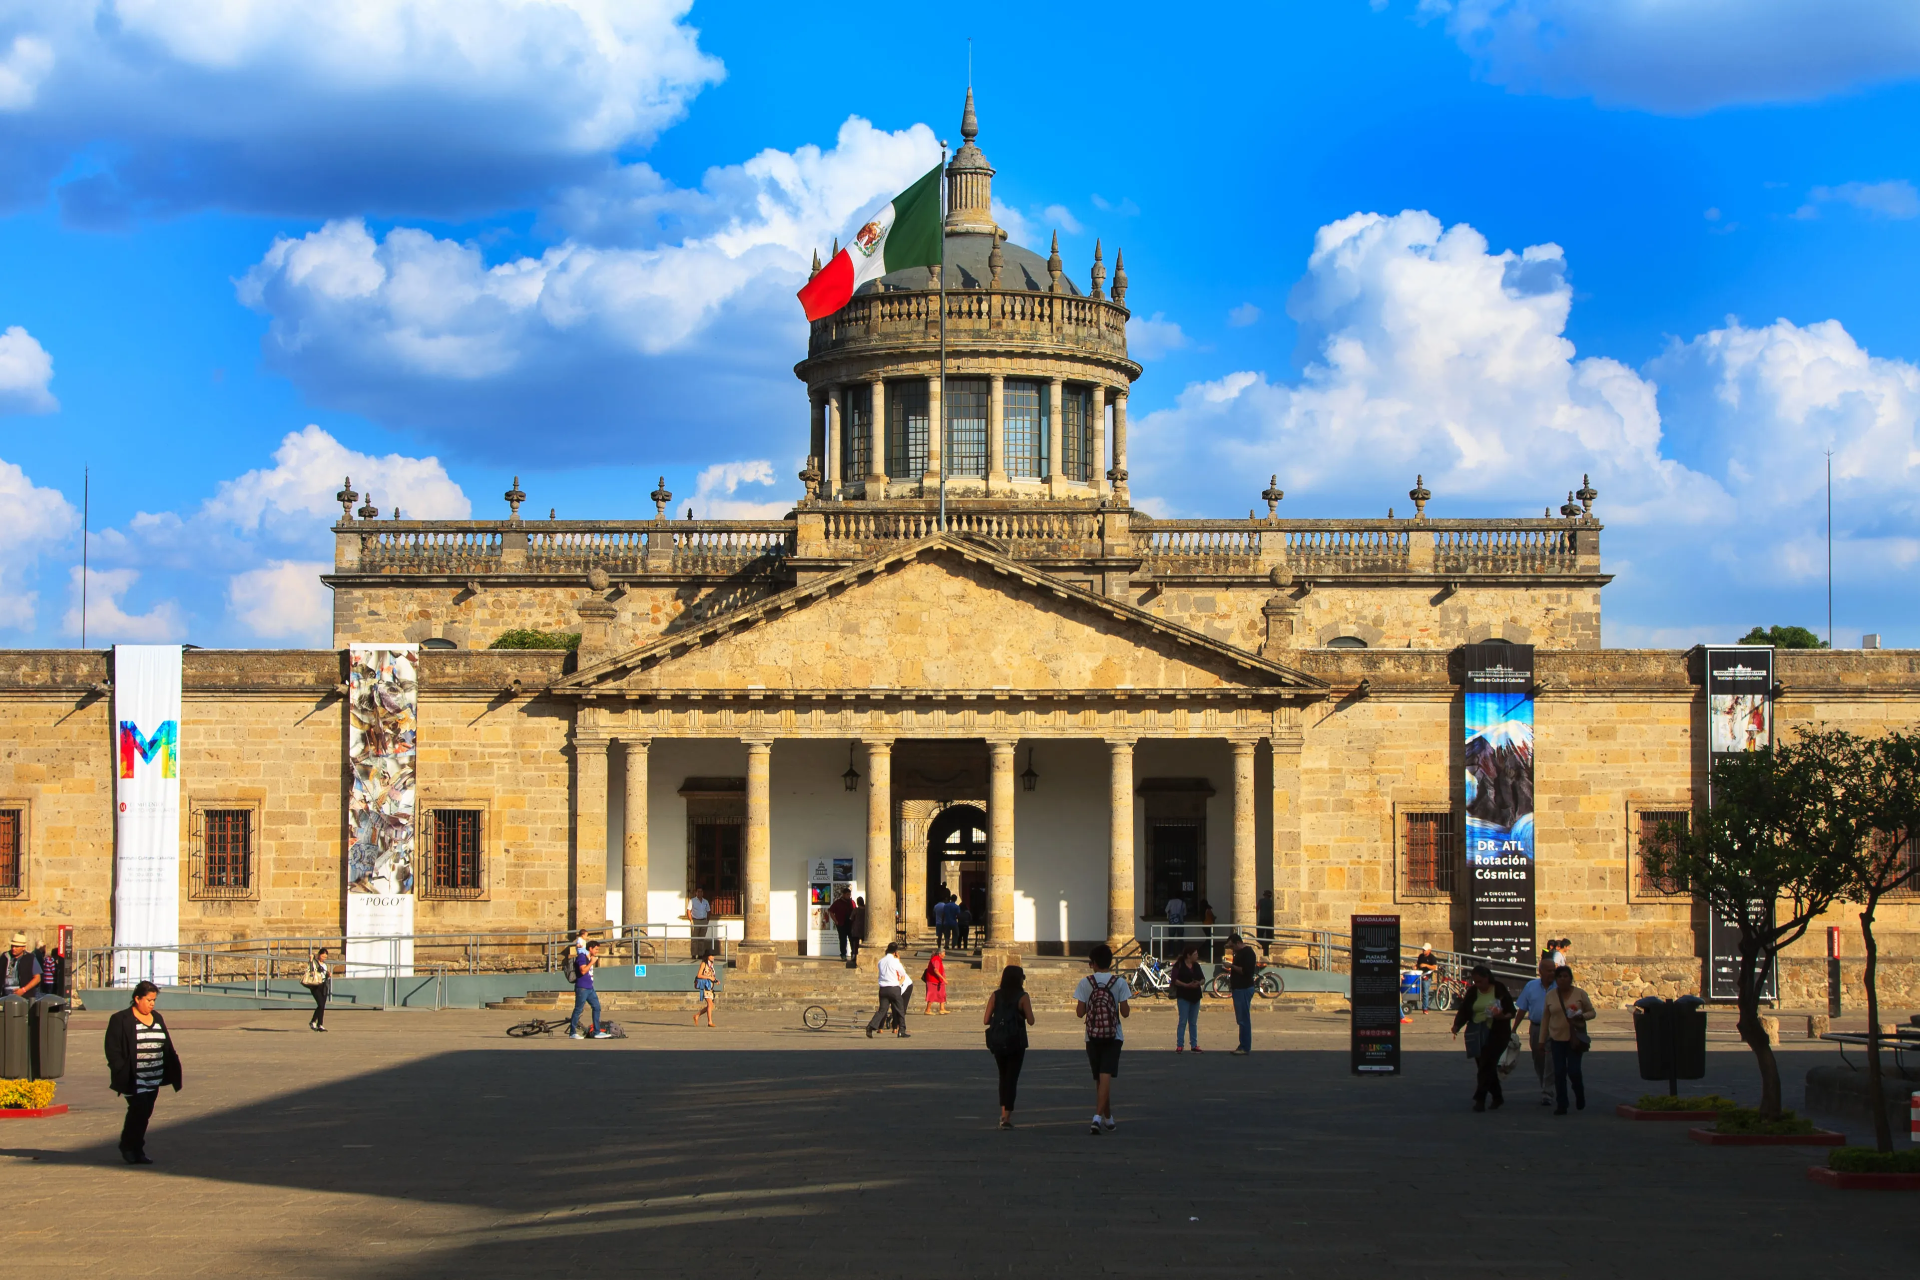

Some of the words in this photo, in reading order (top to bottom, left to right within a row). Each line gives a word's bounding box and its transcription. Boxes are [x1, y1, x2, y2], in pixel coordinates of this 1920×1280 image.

[119, 720, 178, 779] M
[1477, 840, 1499, 851] DR.
[1502, 840, 1525, 851] ATL
[1474, 854, 1527, 866] Rotación
[1475, 868, 1527, 880] Cósmica
